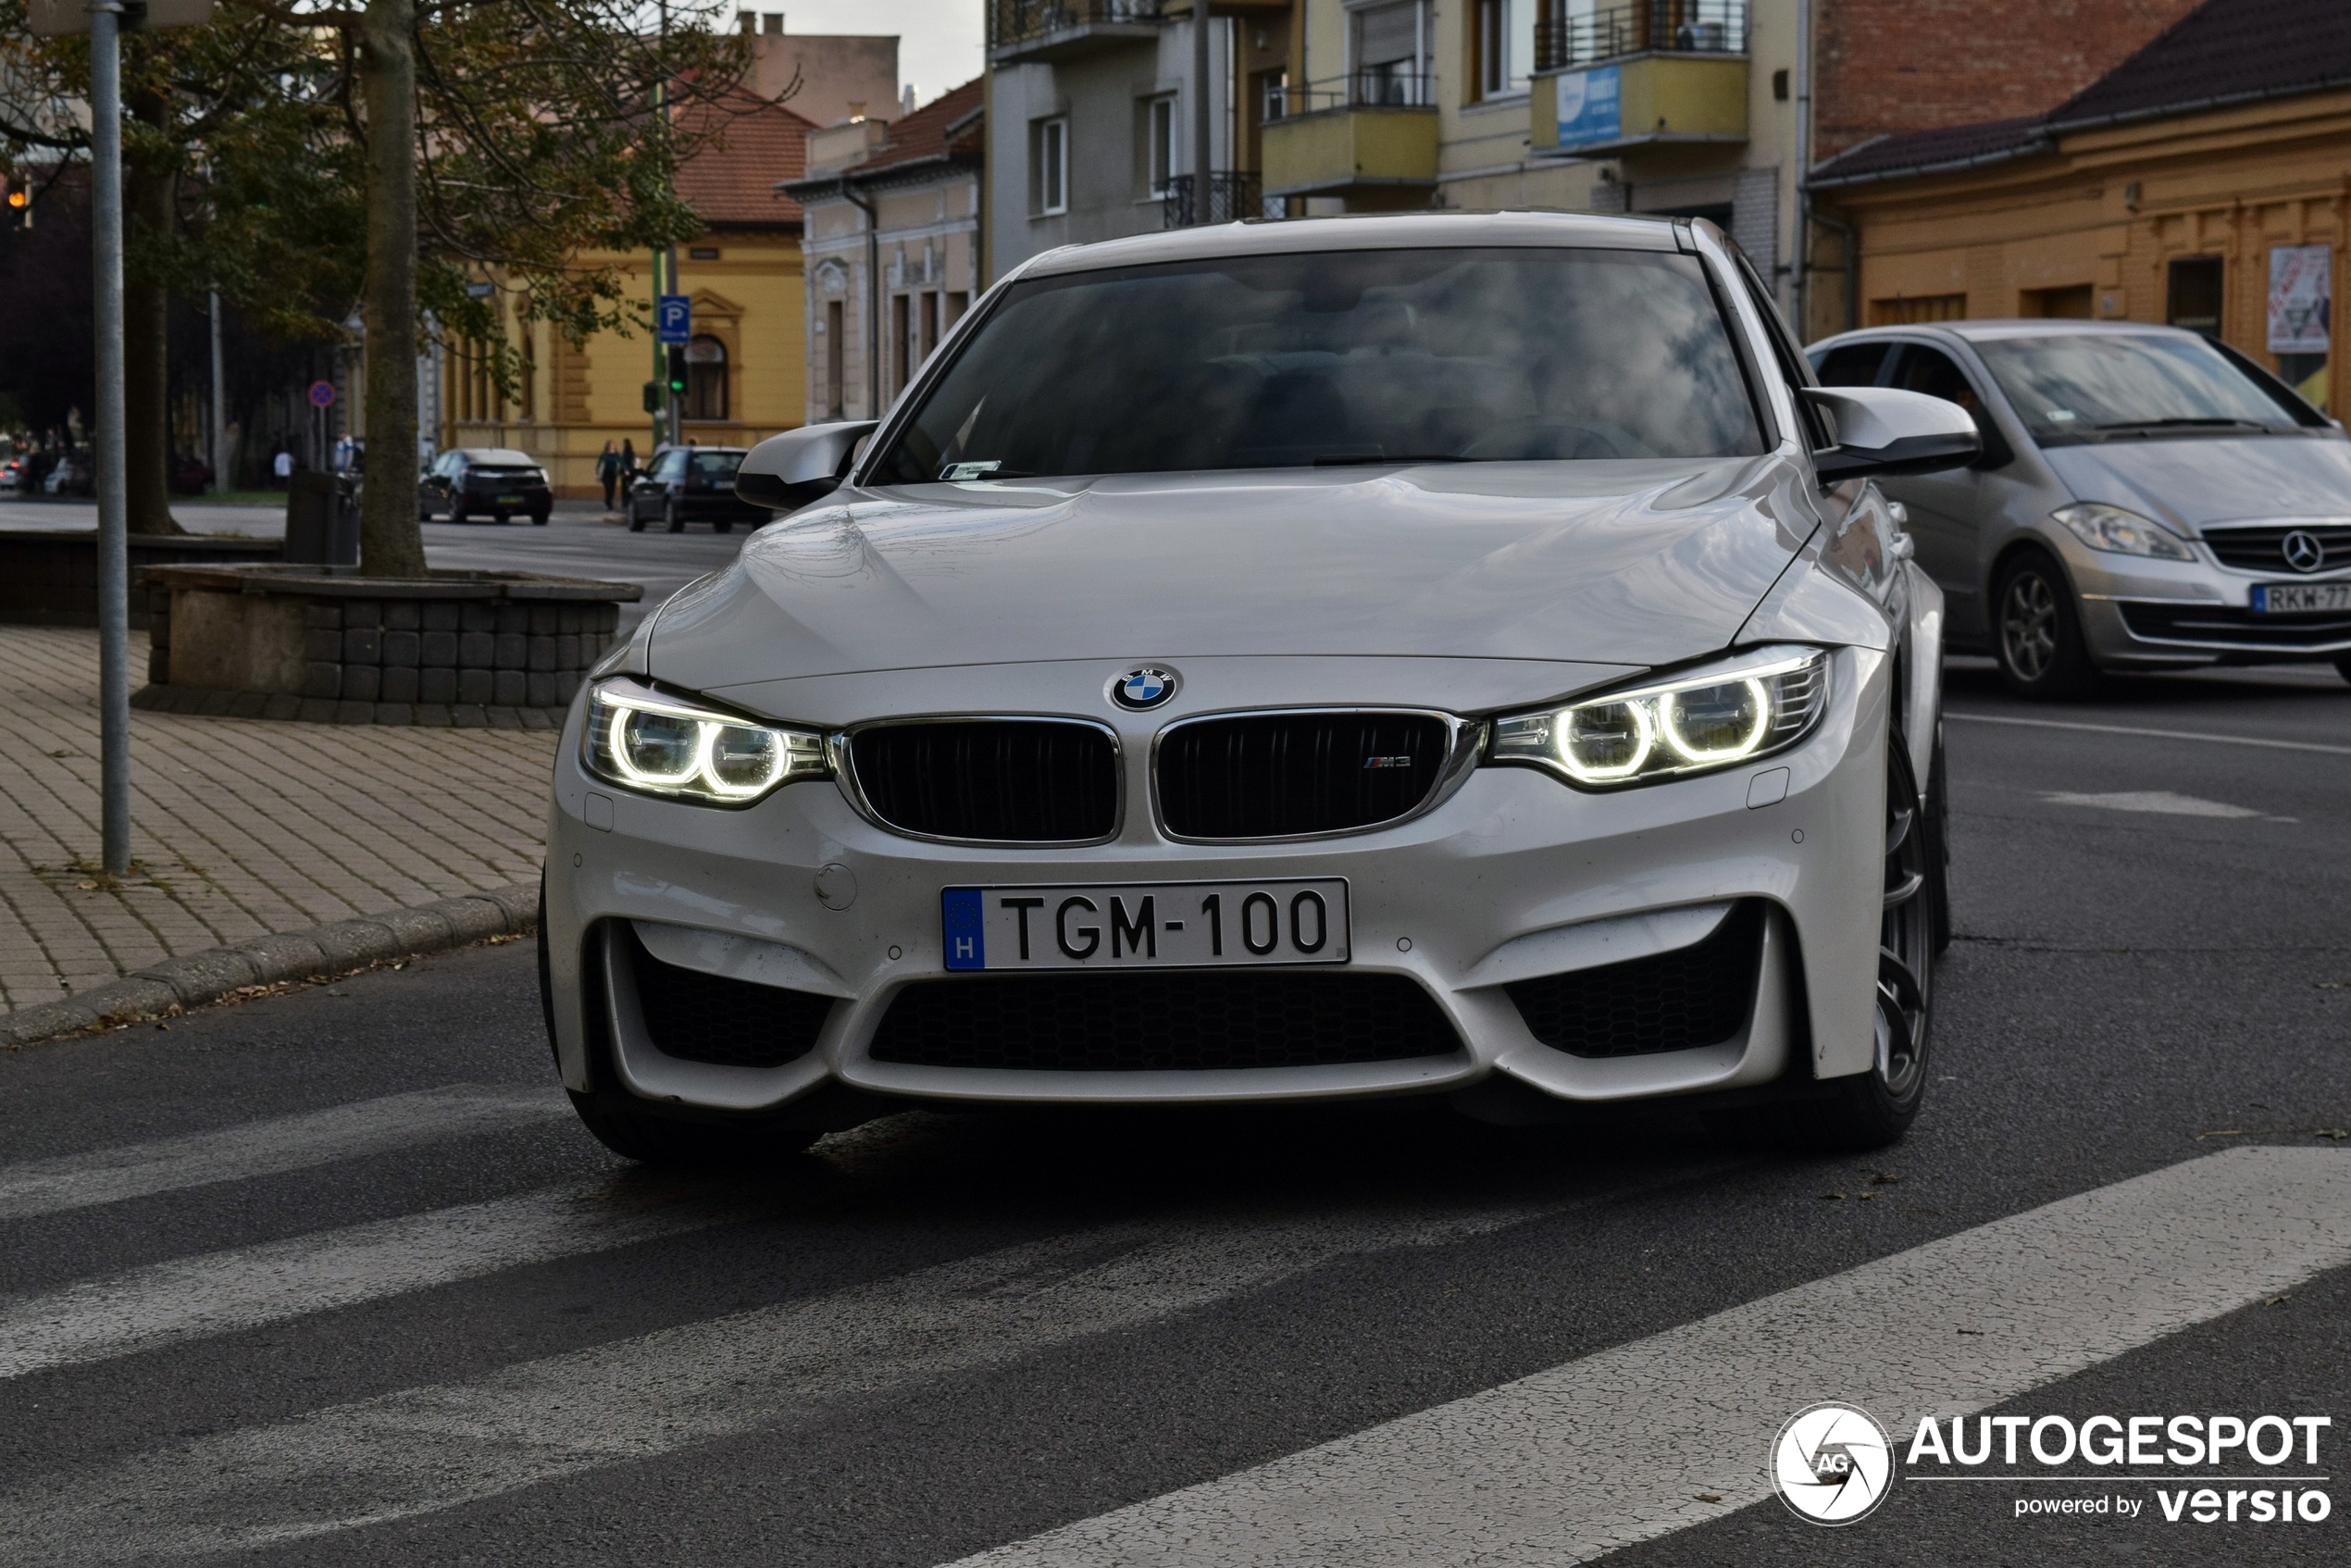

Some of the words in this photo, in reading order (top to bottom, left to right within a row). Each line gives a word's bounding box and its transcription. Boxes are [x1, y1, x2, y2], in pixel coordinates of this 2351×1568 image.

[666, 307, 683, 328] P
[1121, 669, 1173, 682] BMW
[1001, 890, 1327, 960] TGM-100
[956, 937, 973, 959] H
